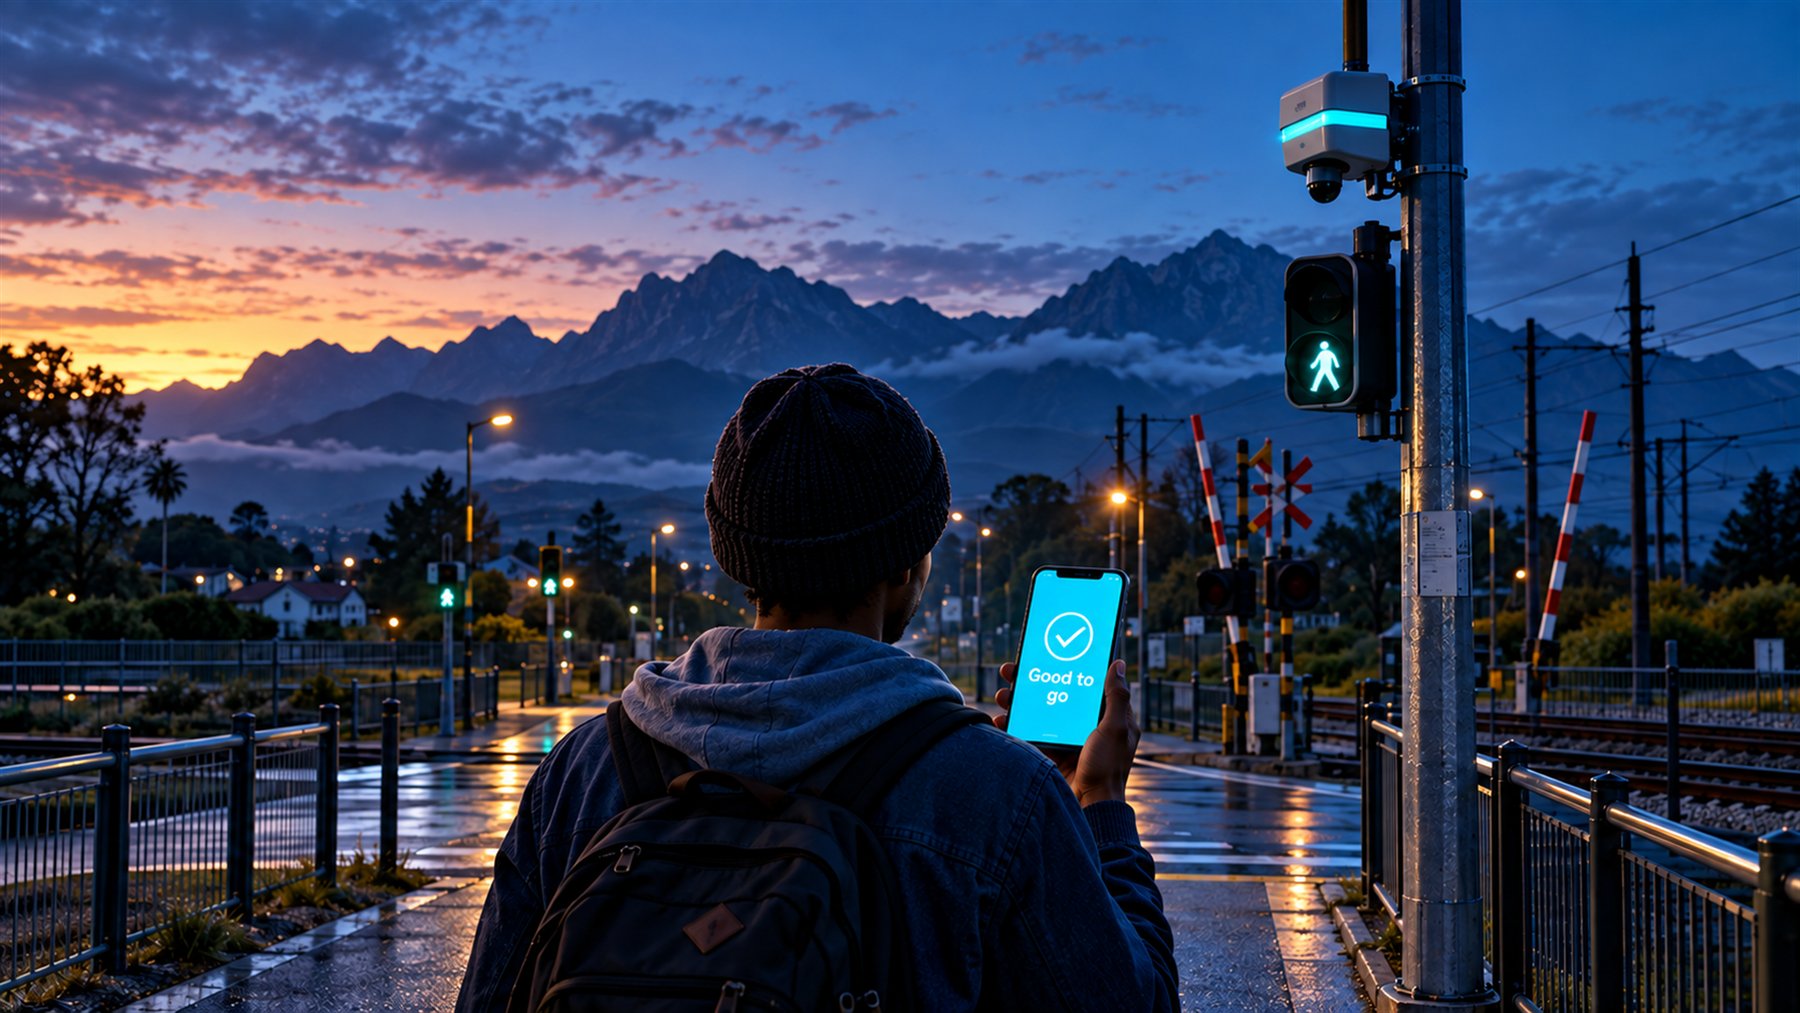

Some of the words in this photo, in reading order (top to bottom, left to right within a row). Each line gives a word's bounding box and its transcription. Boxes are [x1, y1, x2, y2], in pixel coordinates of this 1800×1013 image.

[1028, 667, 1073, 685] Good
[1077, 673, 1094, 687] to
[1046, 690, 1069, 706] go
